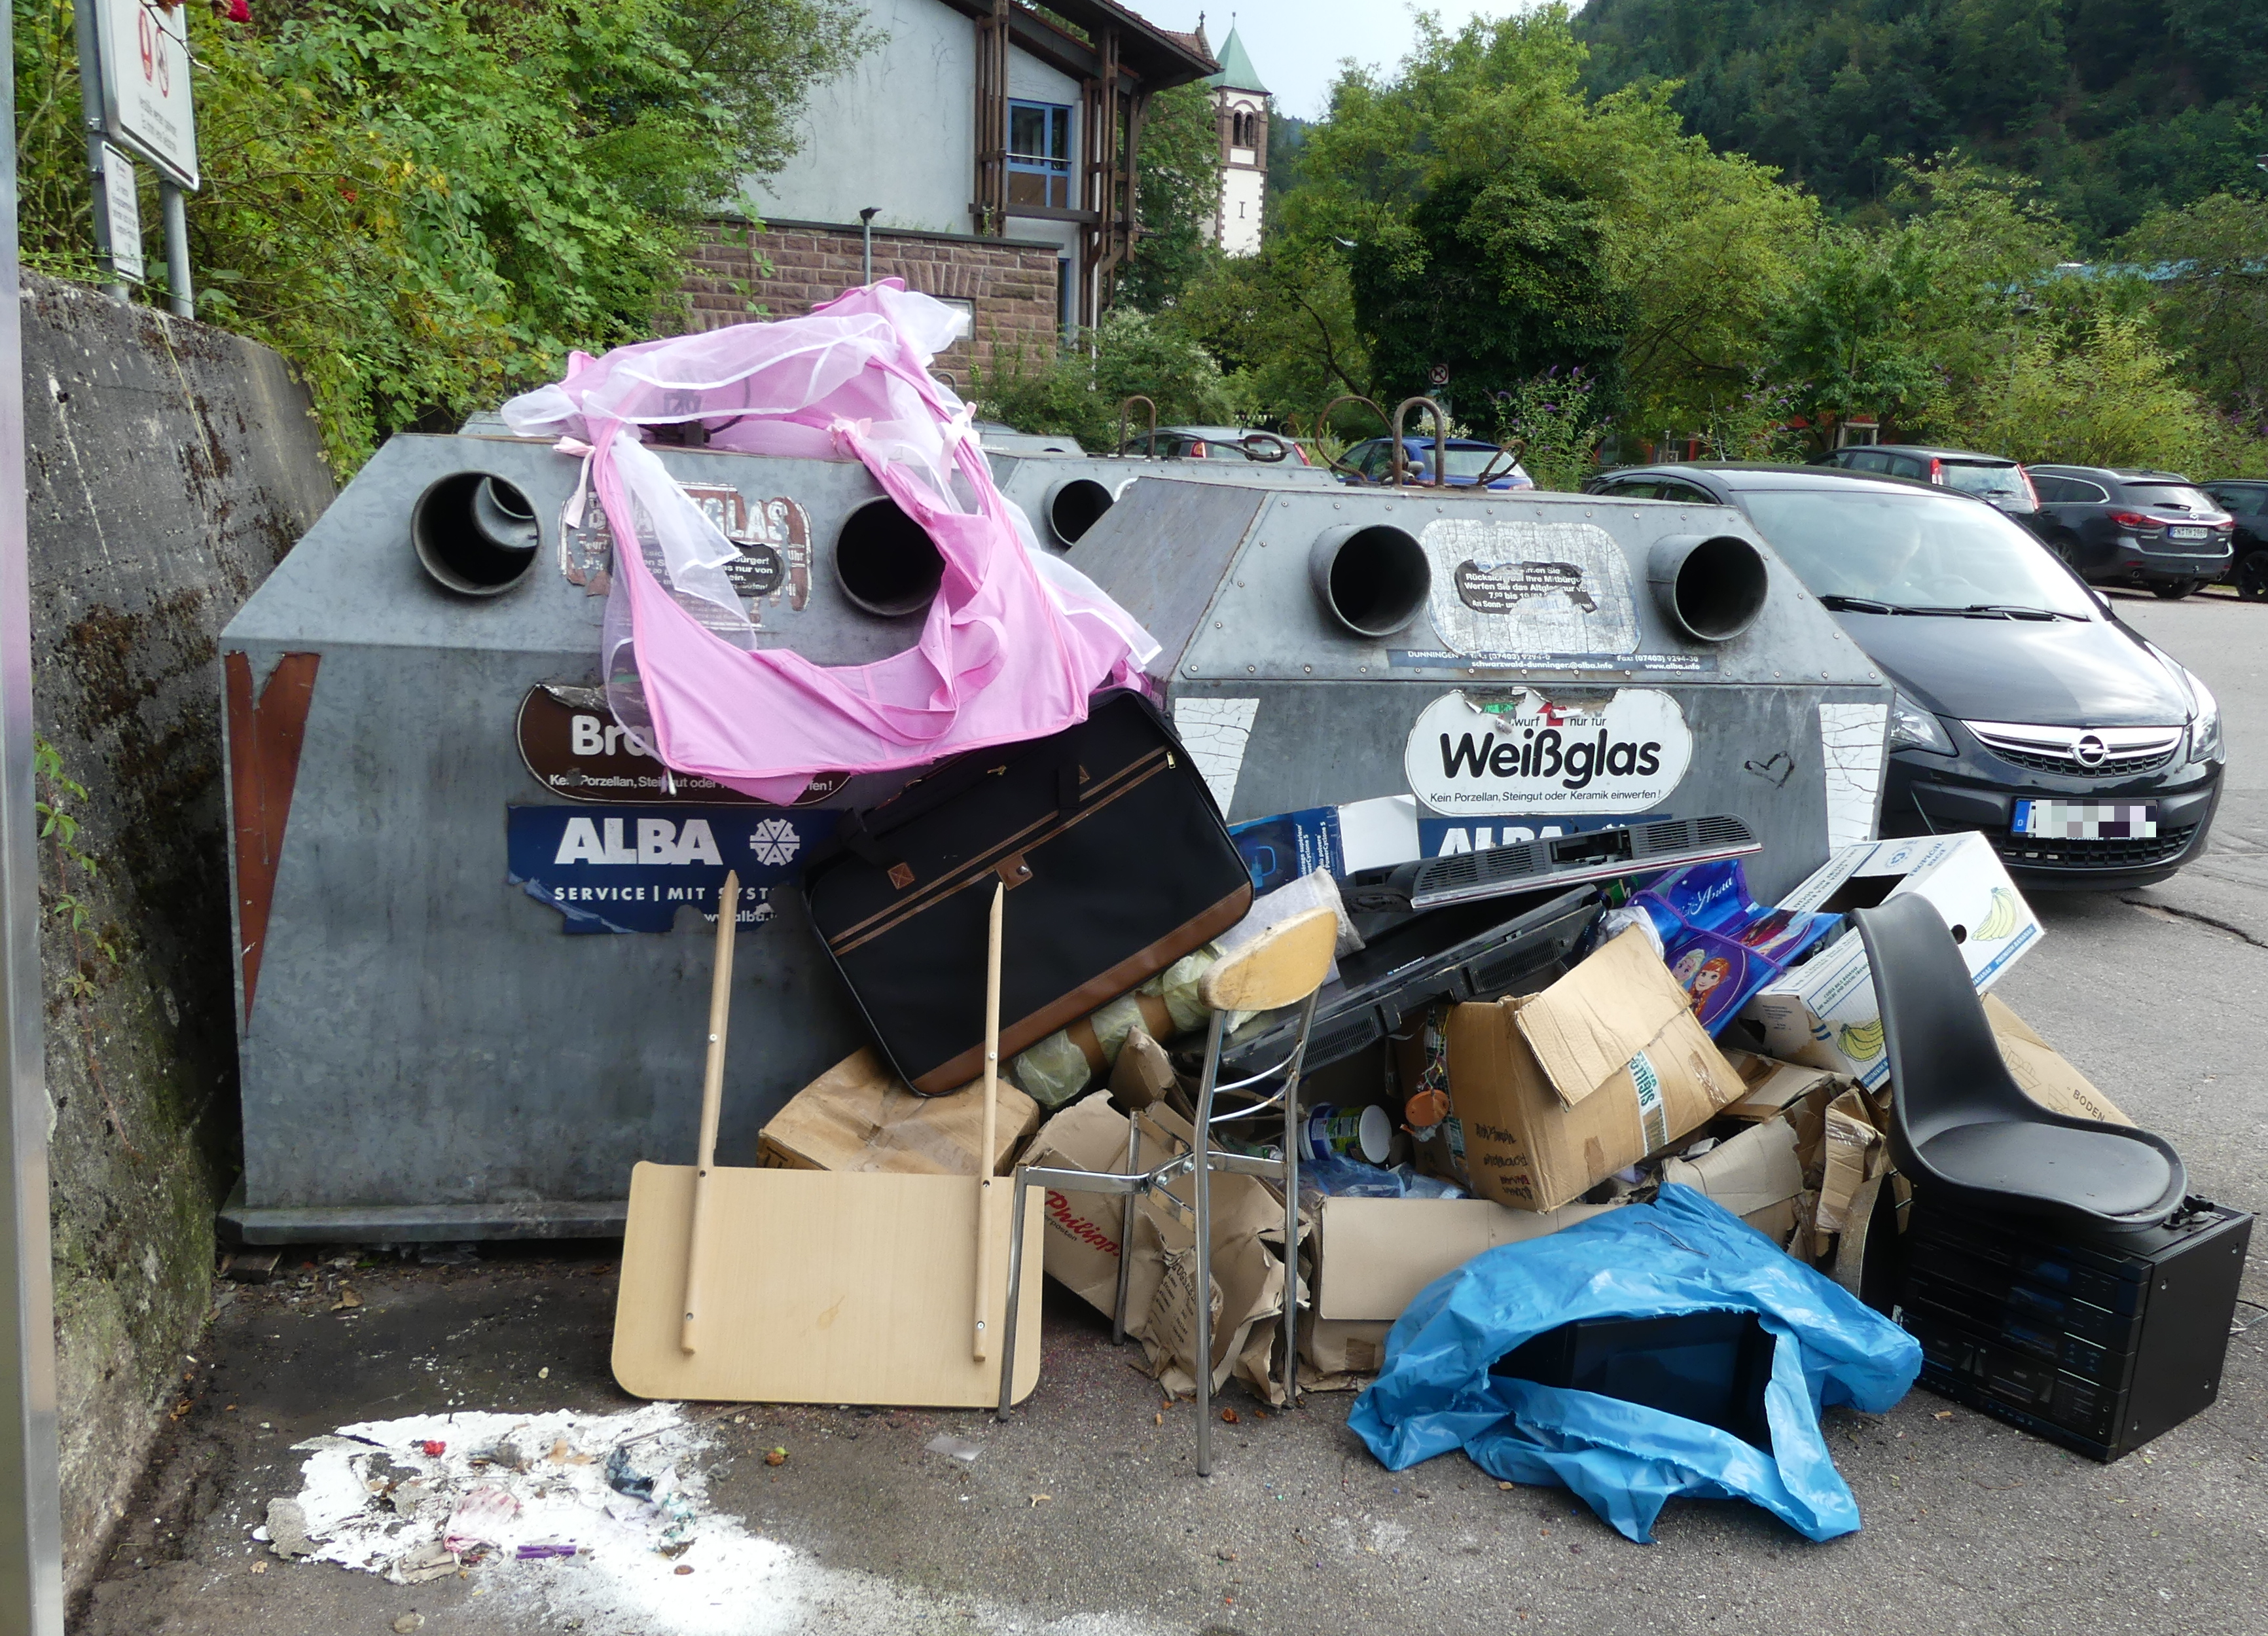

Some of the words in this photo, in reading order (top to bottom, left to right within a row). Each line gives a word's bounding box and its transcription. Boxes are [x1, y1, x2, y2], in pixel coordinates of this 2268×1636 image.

[1464, 582, 1495, 591] Werfen
[1570, 717, 1587, 726] nur
[1439, 727, 1661, 790] Weißglas
[1430, 792, 1451, 803] Kein
[1454, 791, 1501, 803] Porzellan,
[1502, 791, 1543, 803] Steingut
[1545, 791, 1567, 801] oder
[1570, 790, 1609, 800] Keramik
[554, 817, 723, 865] ALBA
[554, 887, 645, 901] SERVICE
[667, 887, 706, 901] MIT
[2073, 1089, 2105, 1121] BODEN
